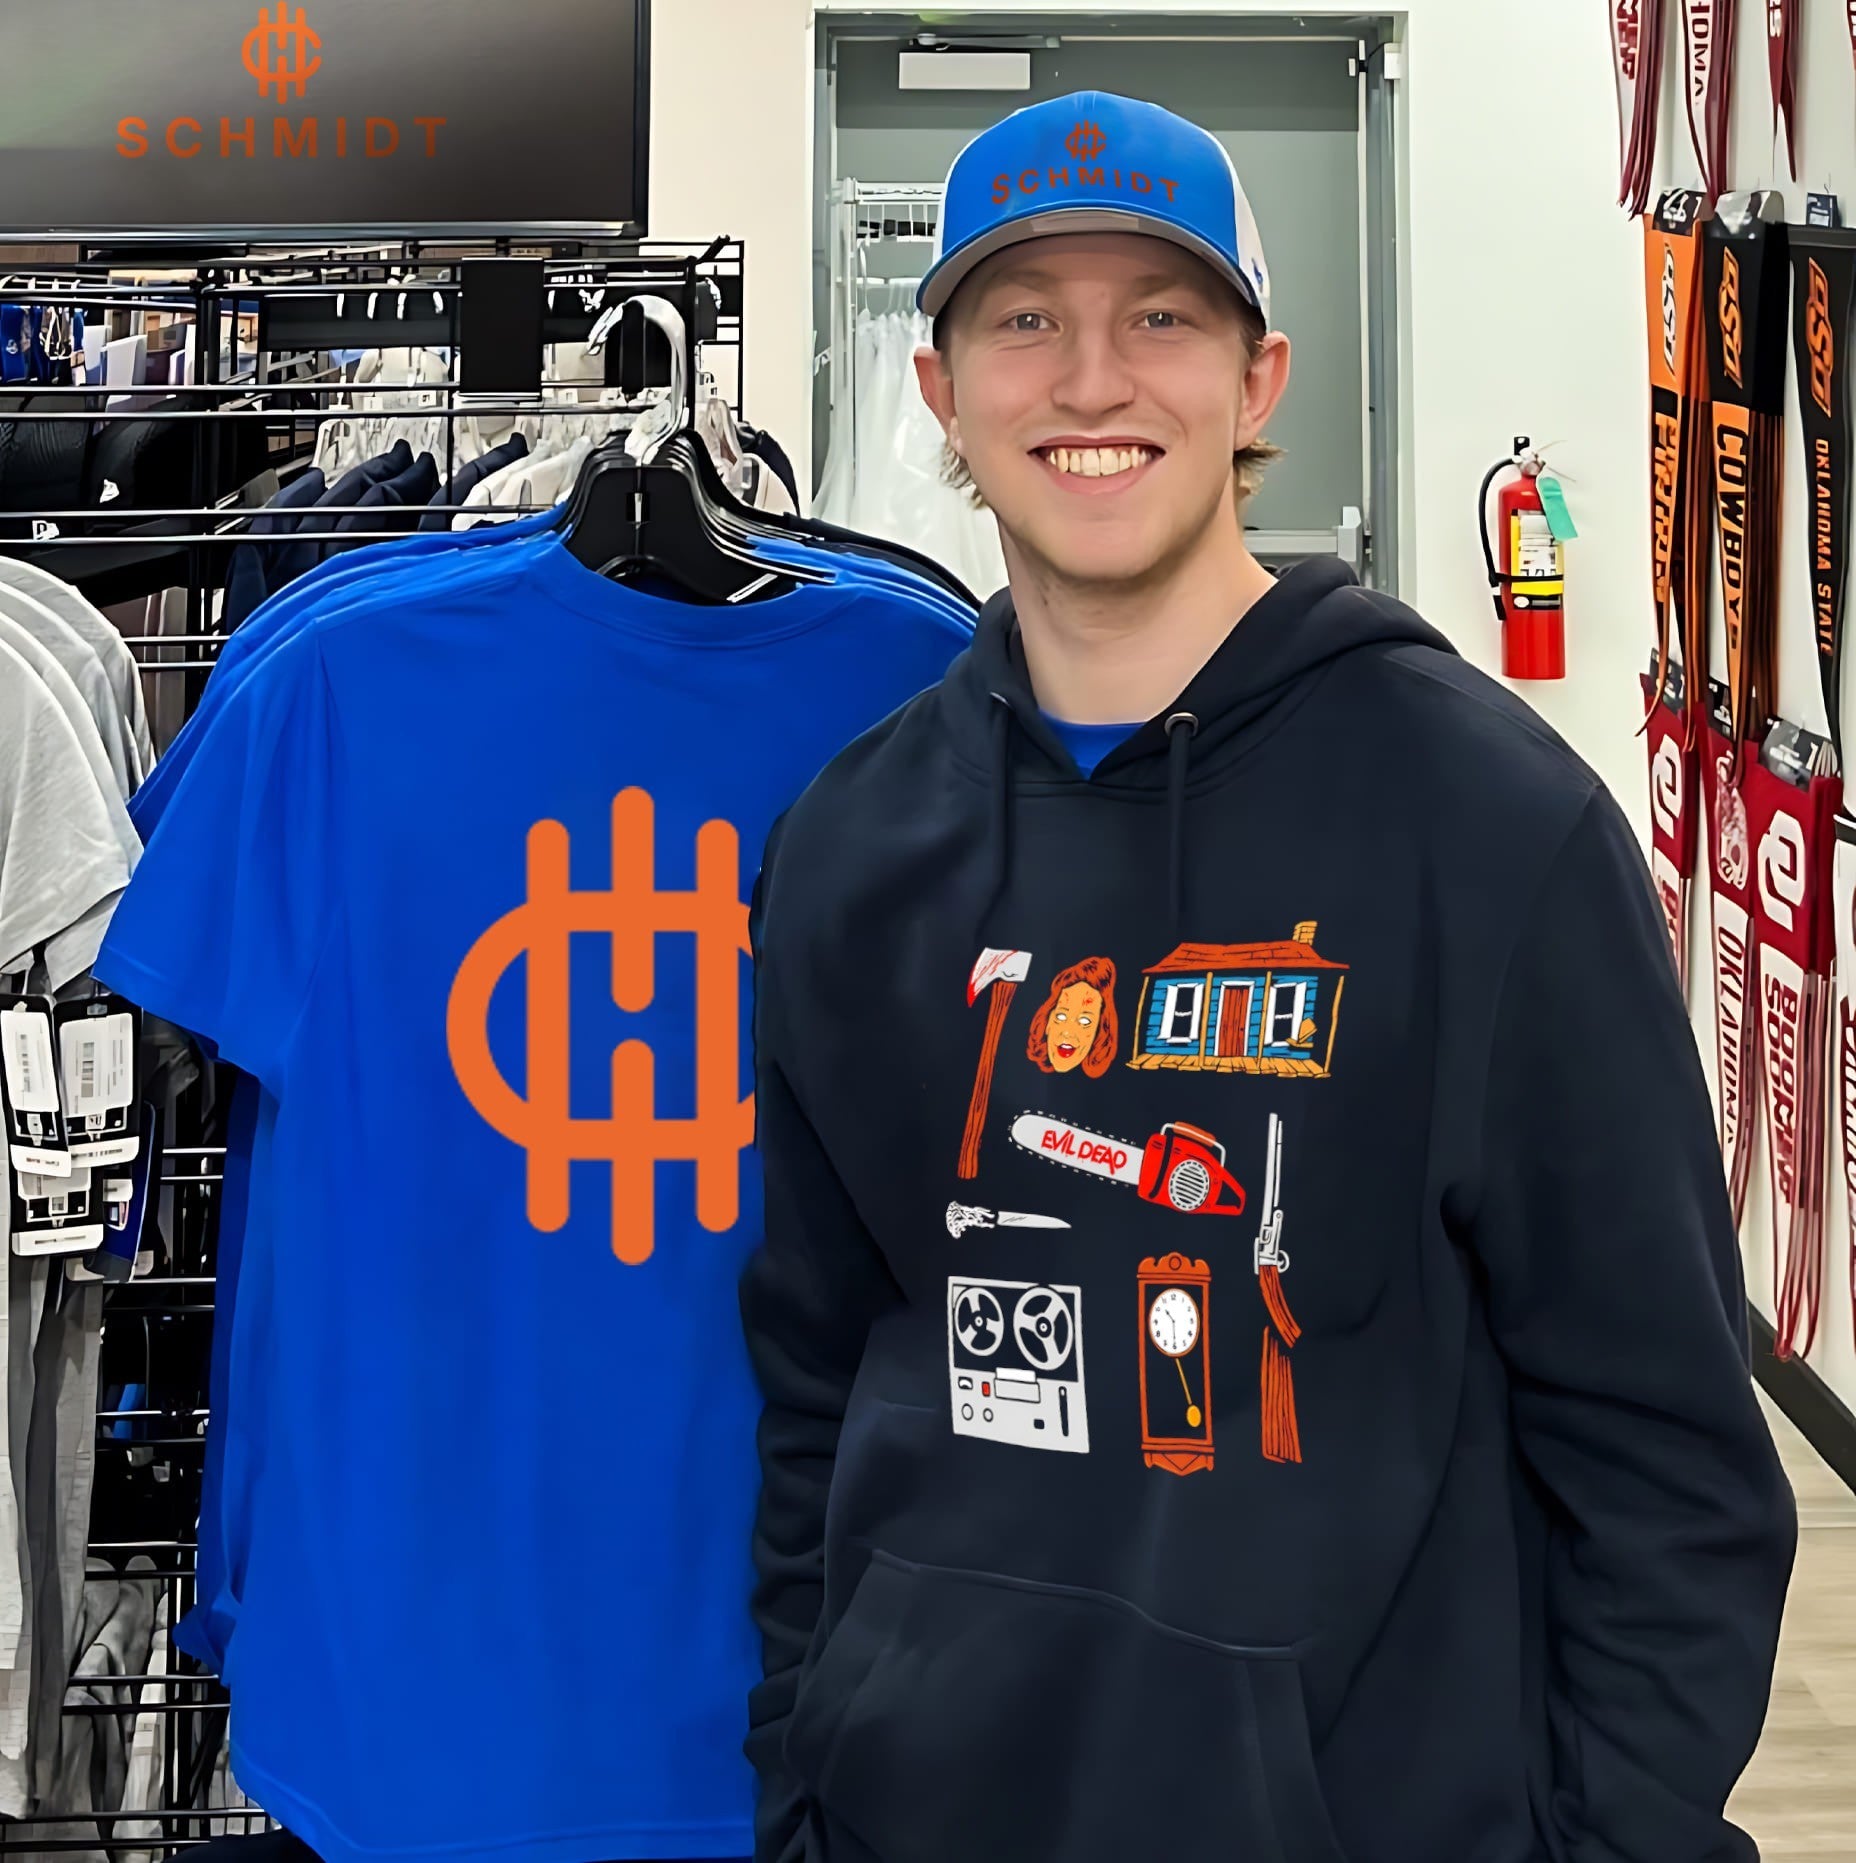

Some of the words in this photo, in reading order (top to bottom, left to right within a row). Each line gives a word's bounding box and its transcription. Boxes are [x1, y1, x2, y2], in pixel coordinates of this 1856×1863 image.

[115, 116, 449, 159] SCHMIDT
[991, 166, 1179, 205] SCHMIDT
[1815, 438, 1832, 570] OKLAHOMA
[1718, 926, 1744, 1143] OKLAHOMA
[1041, 1130, 1076, 1157] EVIL
[1077, 1141, 1128, 1175] DEAD
